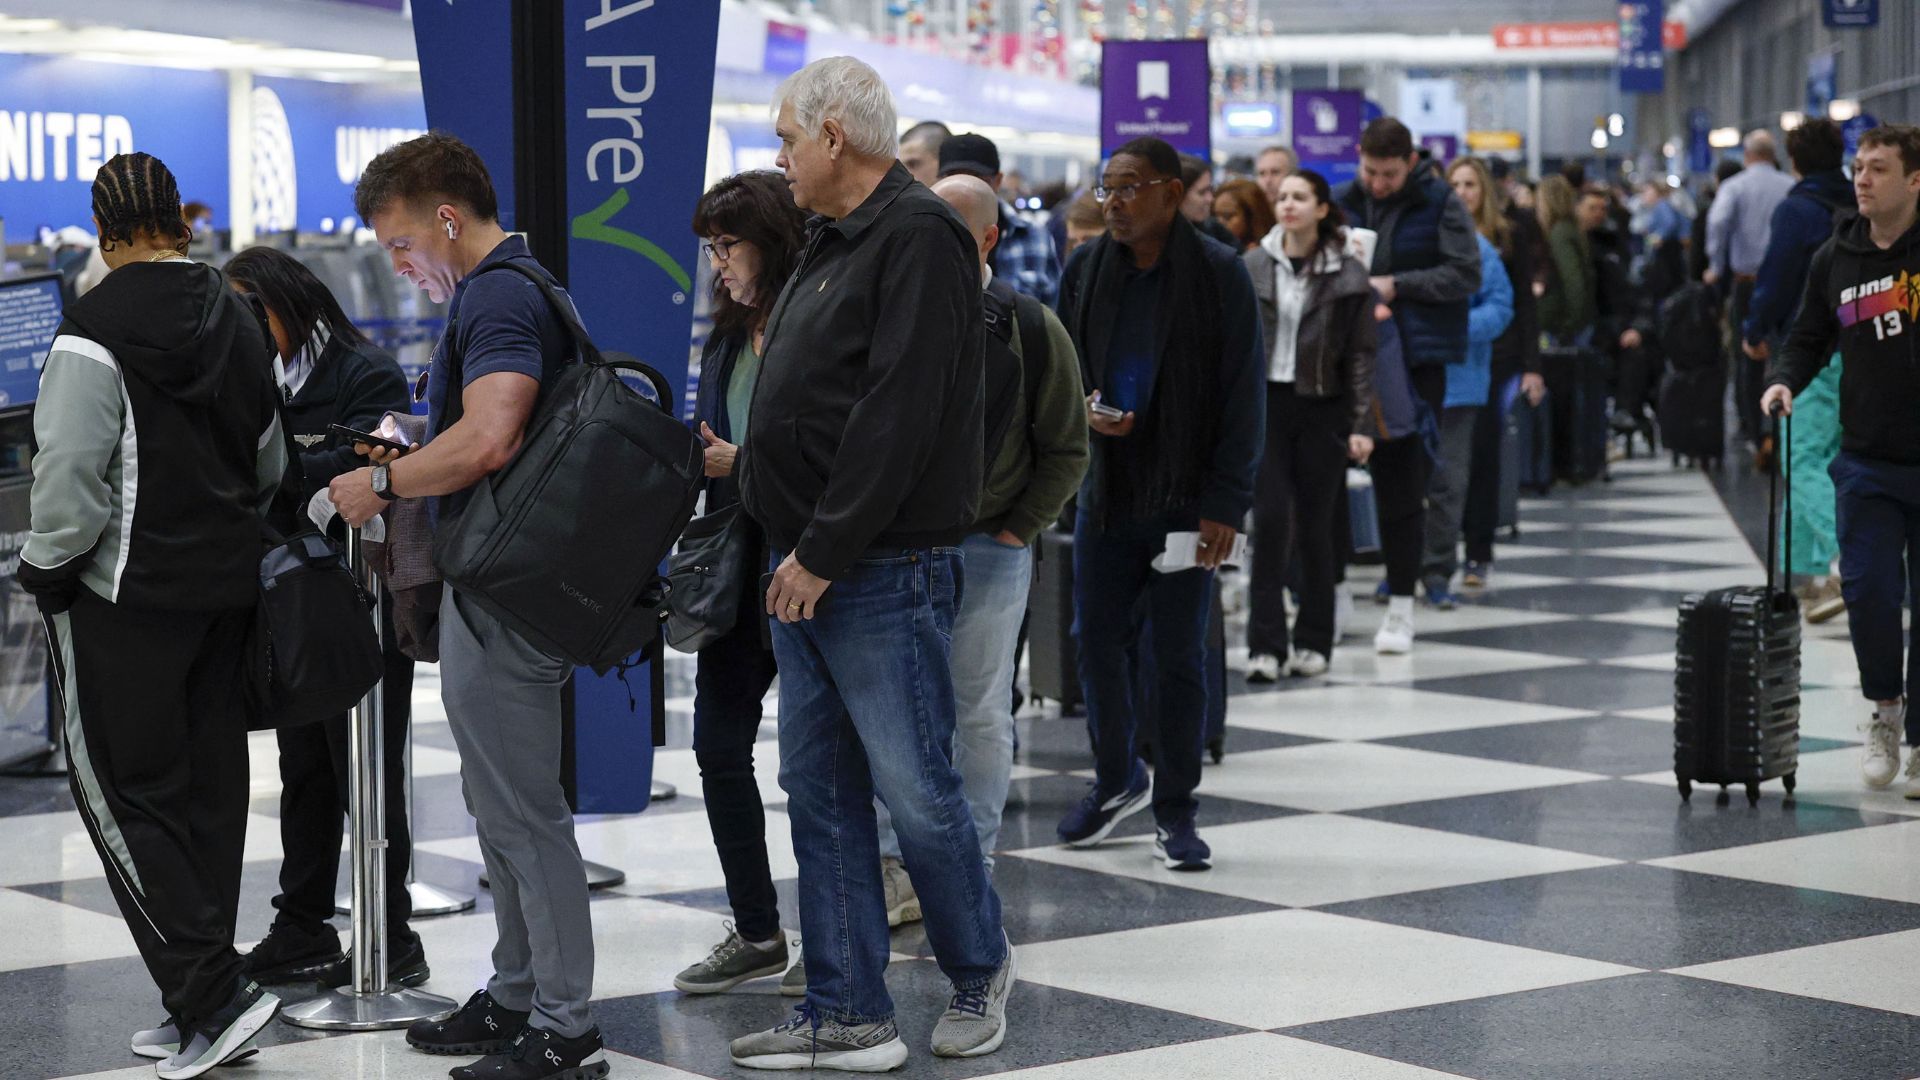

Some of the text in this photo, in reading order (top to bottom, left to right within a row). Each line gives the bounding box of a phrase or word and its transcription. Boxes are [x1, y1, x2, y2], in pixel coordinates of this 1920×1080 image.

[585, 55, 656, 183] Pre
[1873, 309, 1903, 341] 13
[560, 581, 604, 616] NOMATIC
